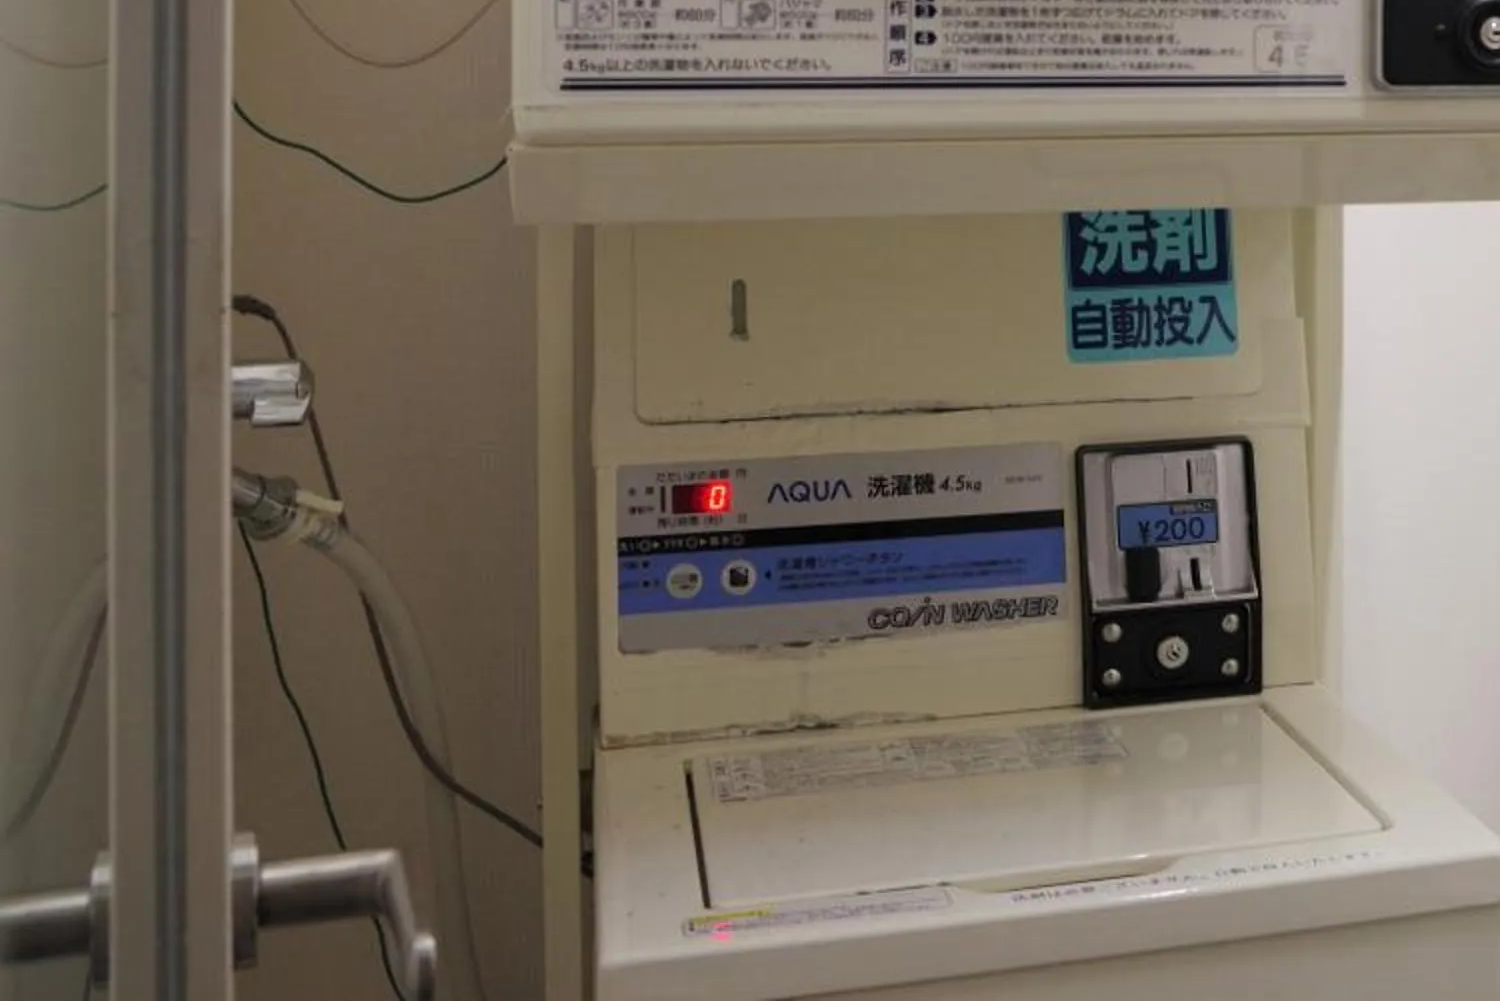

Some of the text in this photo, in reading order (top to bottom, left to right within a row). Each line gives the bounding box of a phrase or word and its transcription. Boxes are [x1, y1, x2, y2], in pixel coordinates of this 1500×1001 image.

[1079, 210, 1219, 276] 洗剤
[1071, 295, 1237, 350] 自動投入
[709, 485, 726, 510] 0
[767, 479, 853, 504] AQUA
[867, 473, 935, 499] 洗濯機
[938, 475, 983, 493] 4.5kg
[1138, 515, 1205, 544] ¥200
[867, 595, 1059, 630] COIN WASHER
